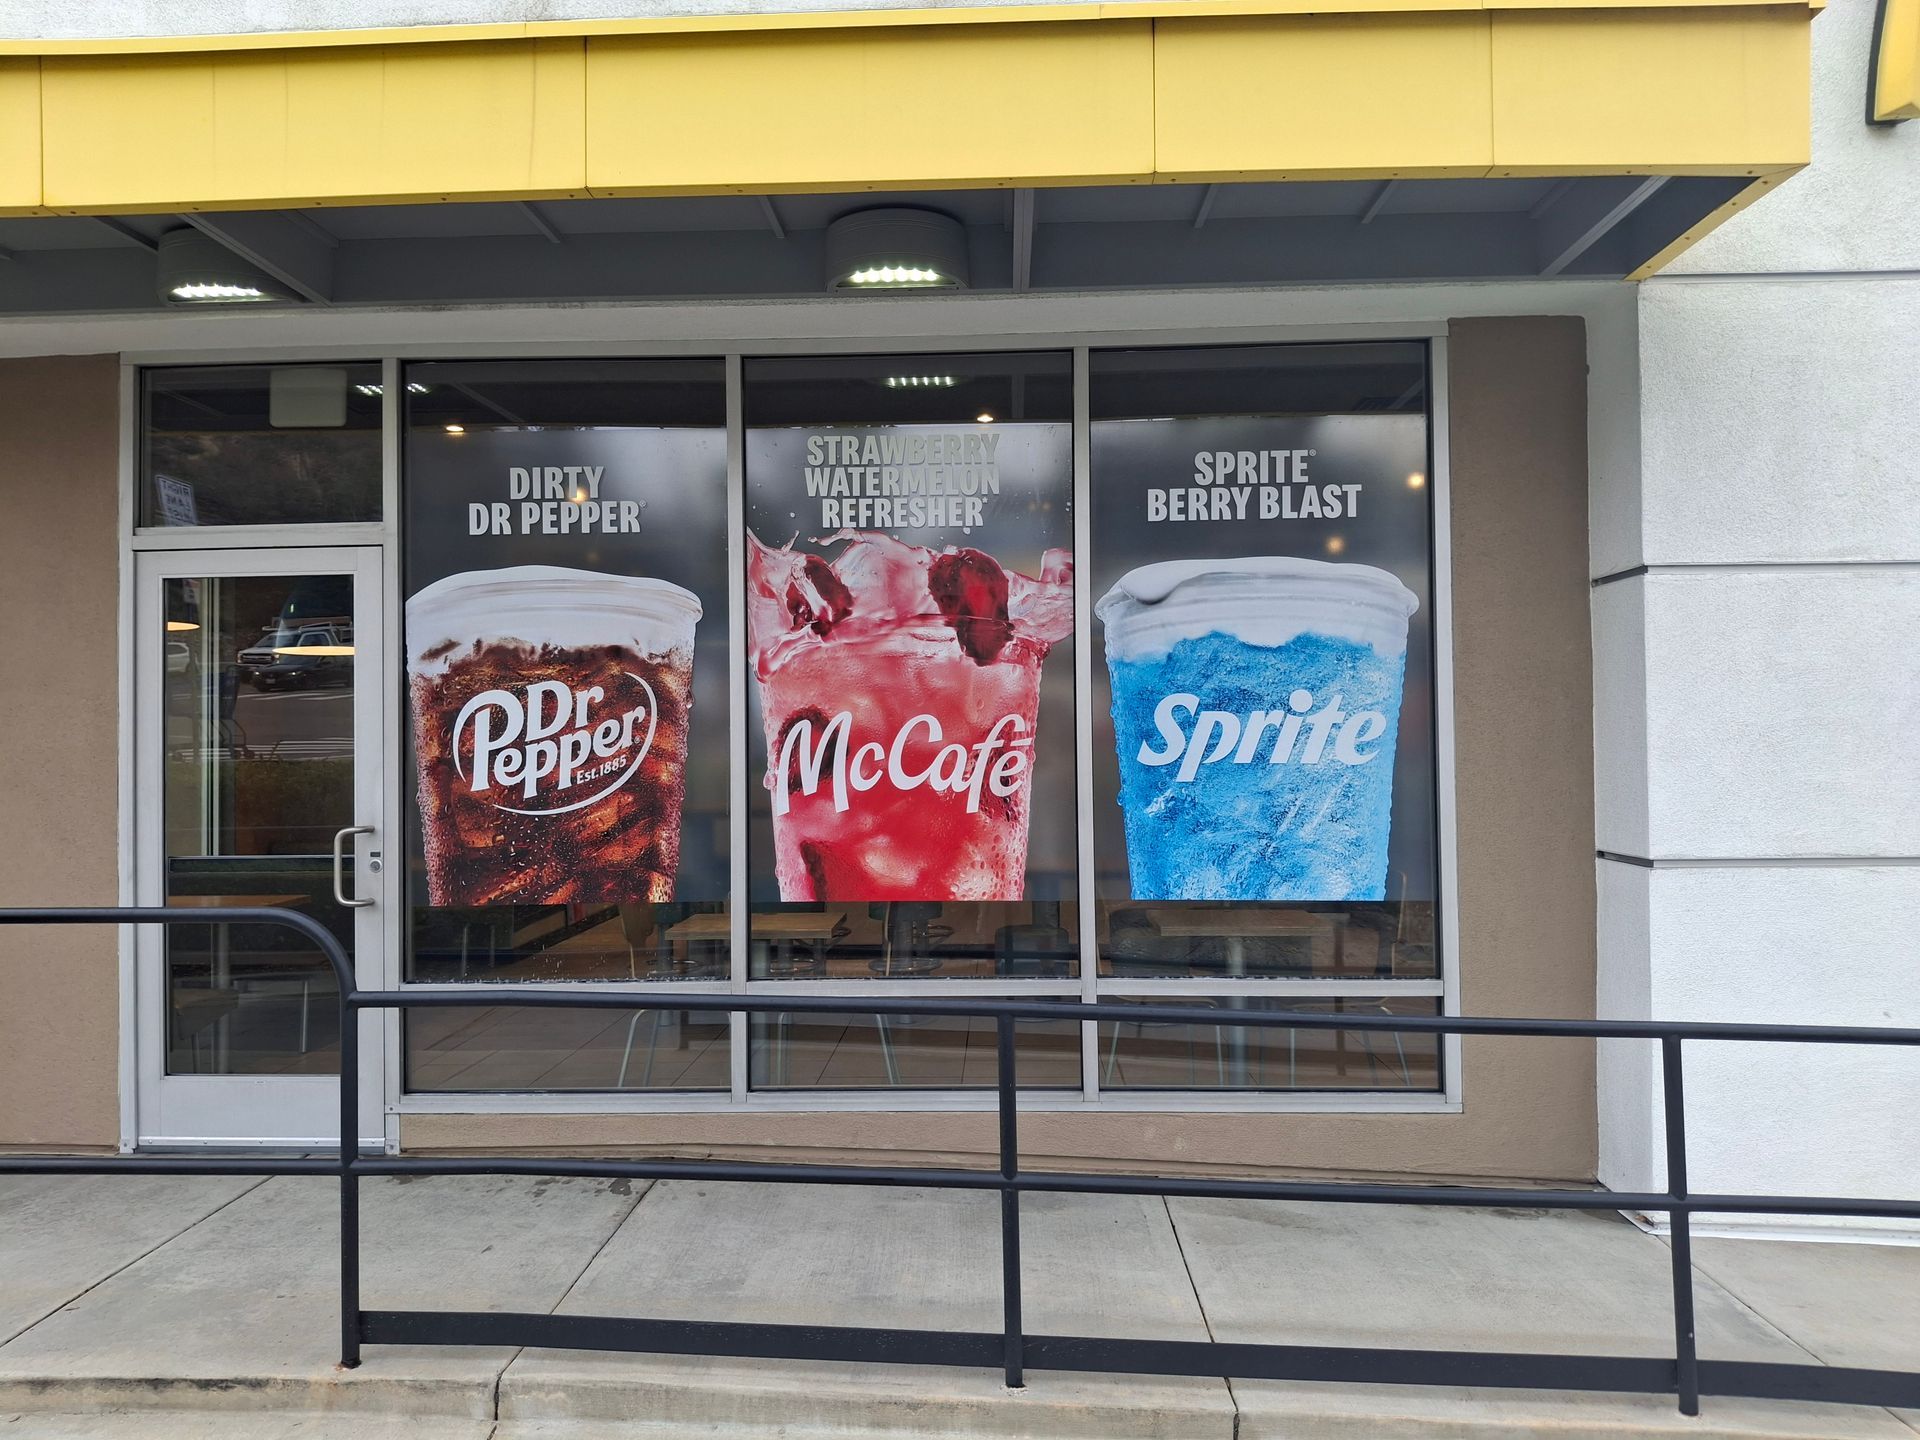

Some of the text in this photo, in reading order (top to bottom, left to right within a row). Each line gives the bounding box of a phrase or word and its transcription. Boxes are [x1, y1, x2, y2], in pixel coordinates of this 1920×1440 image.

[807, 434, 1000, 466] STRAWBERRY
[509, 466, 605, 500] DIRTY
[804, 466, 1000, 497] WATERMELON
[468, 502, 512, 536] DR
[1148, 484, 1363, 522] BERRY BLAST
[525, 680, 605, 742] Dr
[1137, 689, 1387, 783] Sprite
